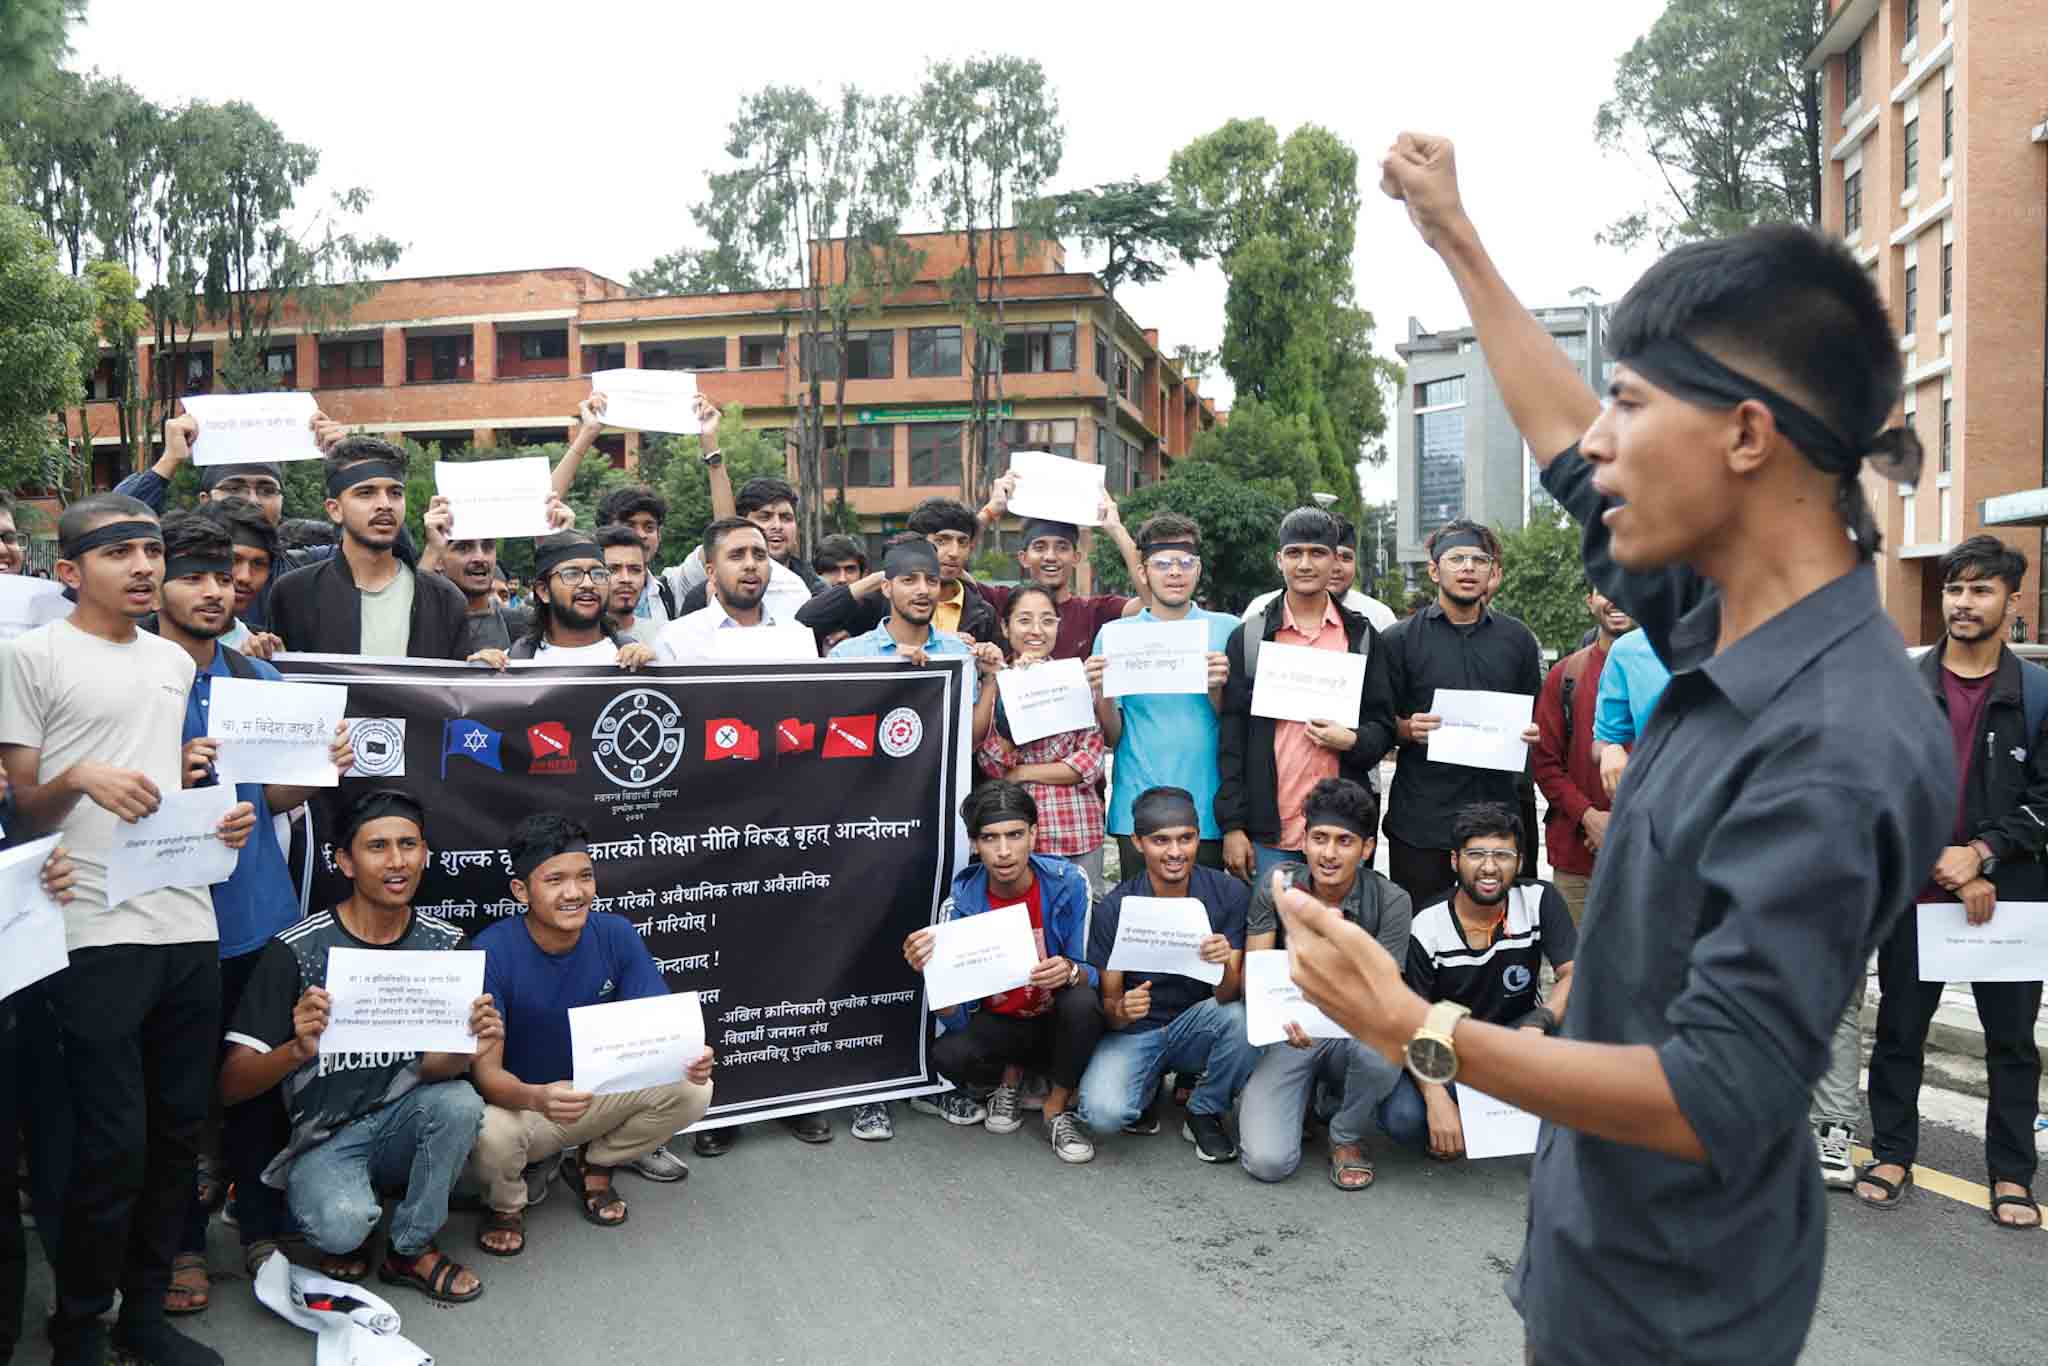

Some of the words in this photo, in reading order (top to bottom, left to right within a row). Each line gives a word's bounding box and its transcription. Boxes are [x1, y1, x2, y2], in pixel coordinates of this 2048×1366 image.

[440, 849, 494, 876] शुल्क
[649, 830, 697, 857] शिक्षा
[700, 825, 741, 851] नीति
[793, 823, 831, 851] बृहत्
[617, 888, 657, 911] गरेको
[659, 880, 729, 905] अवैधानिक
[732, 879, 760, 896] तथा
[762, 870, 832, 893] अवैज्ञानिक
[656, 911, 707, 935] गरियोस्
[764, 998, 826, 1019] क्रान्तिकारी
[829, 993, 869, 1016] पुल्चोक
[767, 1025, 807, 1041] जनमत
[809, 1020, 830, 1036] संघ
[792, 1040, 833, 1062] पुल्चोक
